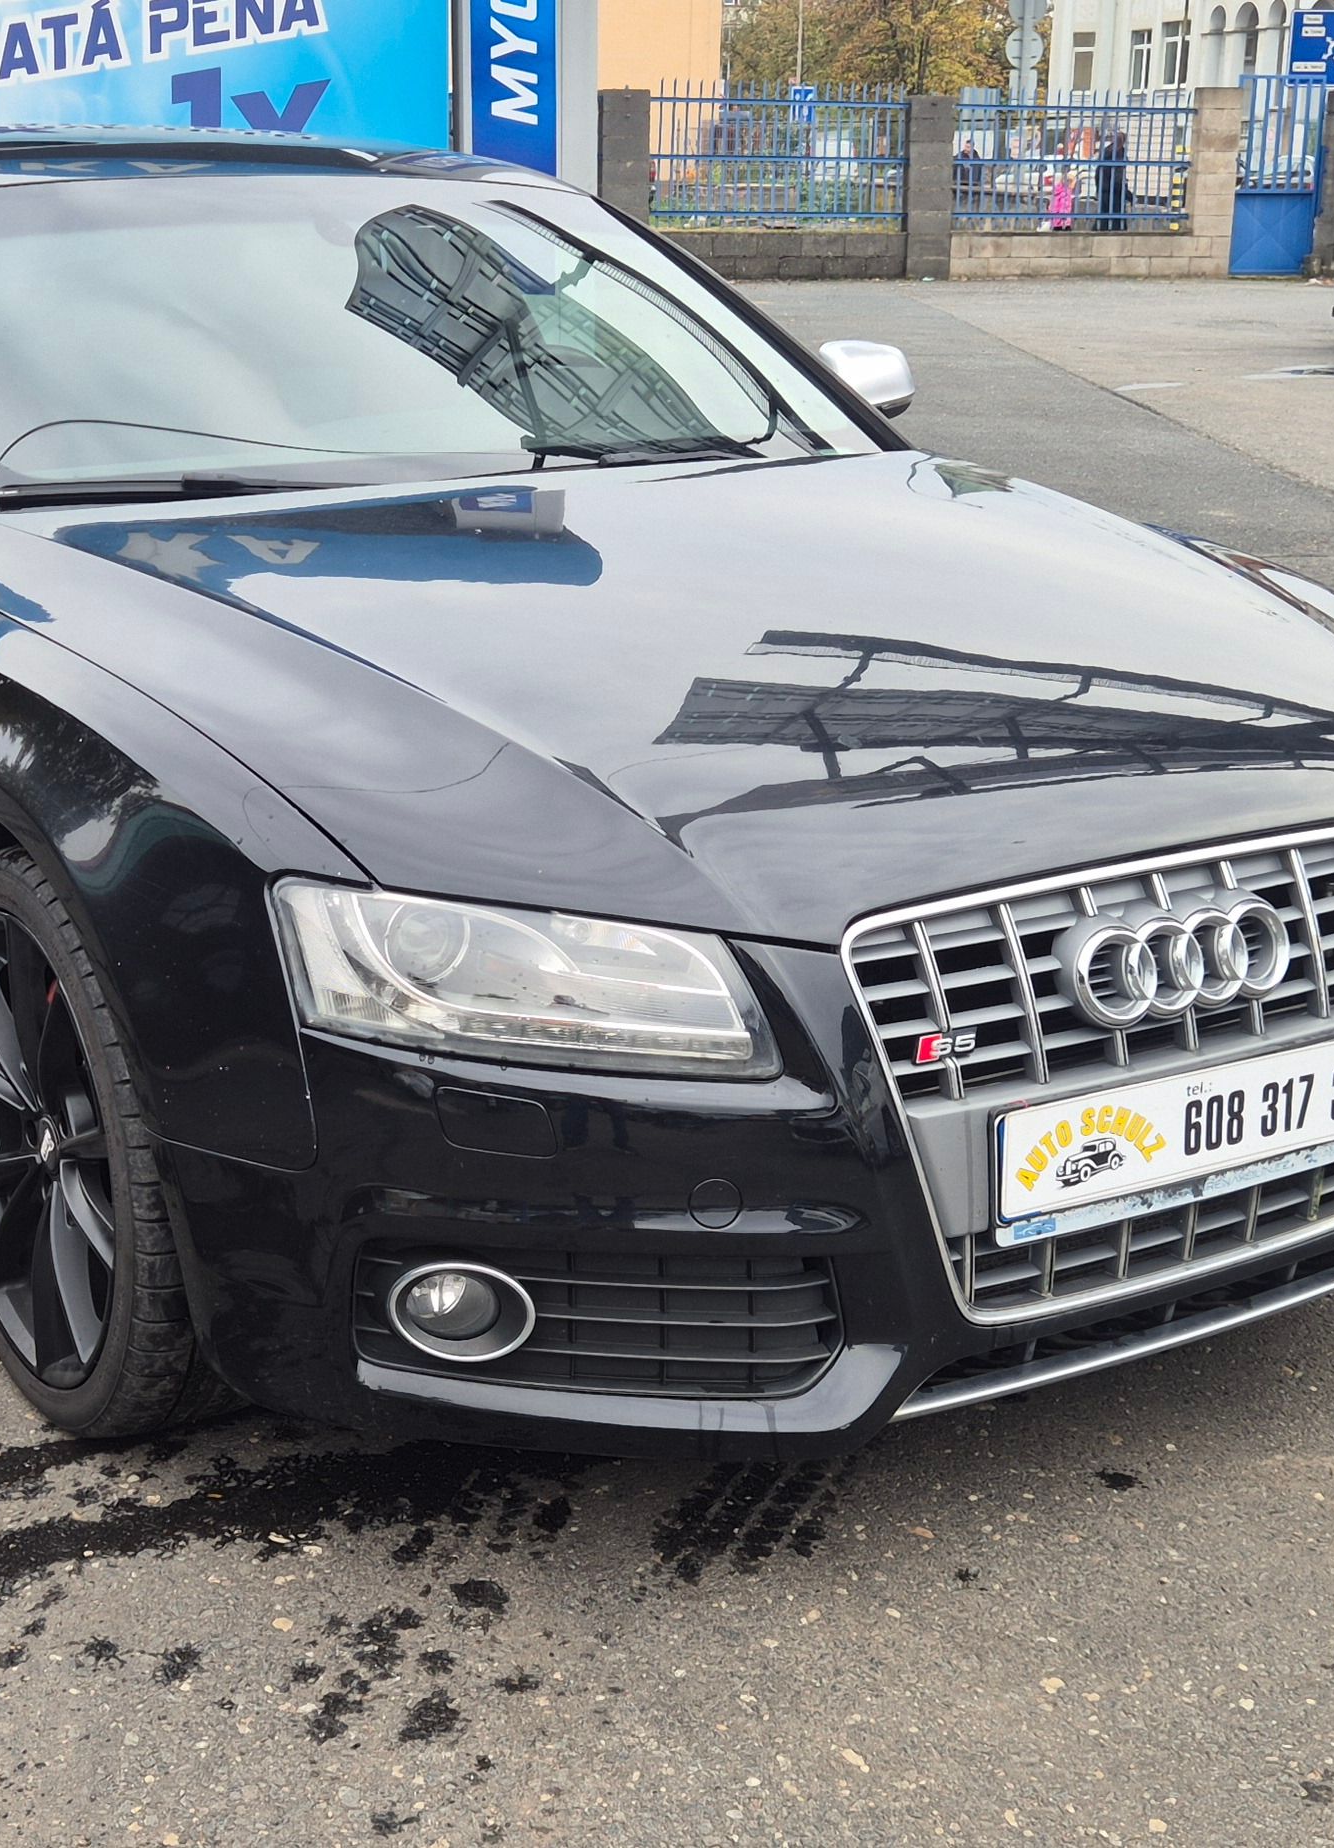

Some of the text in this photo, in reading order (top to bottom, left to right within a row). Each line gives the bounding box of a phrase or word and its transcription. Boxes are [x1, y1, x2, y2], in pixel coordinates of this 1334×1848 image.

[929, 1033, 976, 1058] S5
[1014, 1104, 1167, 1192] AUTO SCHULZ
[1184, 1090, 1245, 1156] 608
[1260, 1073, 1315, 1138] 317
